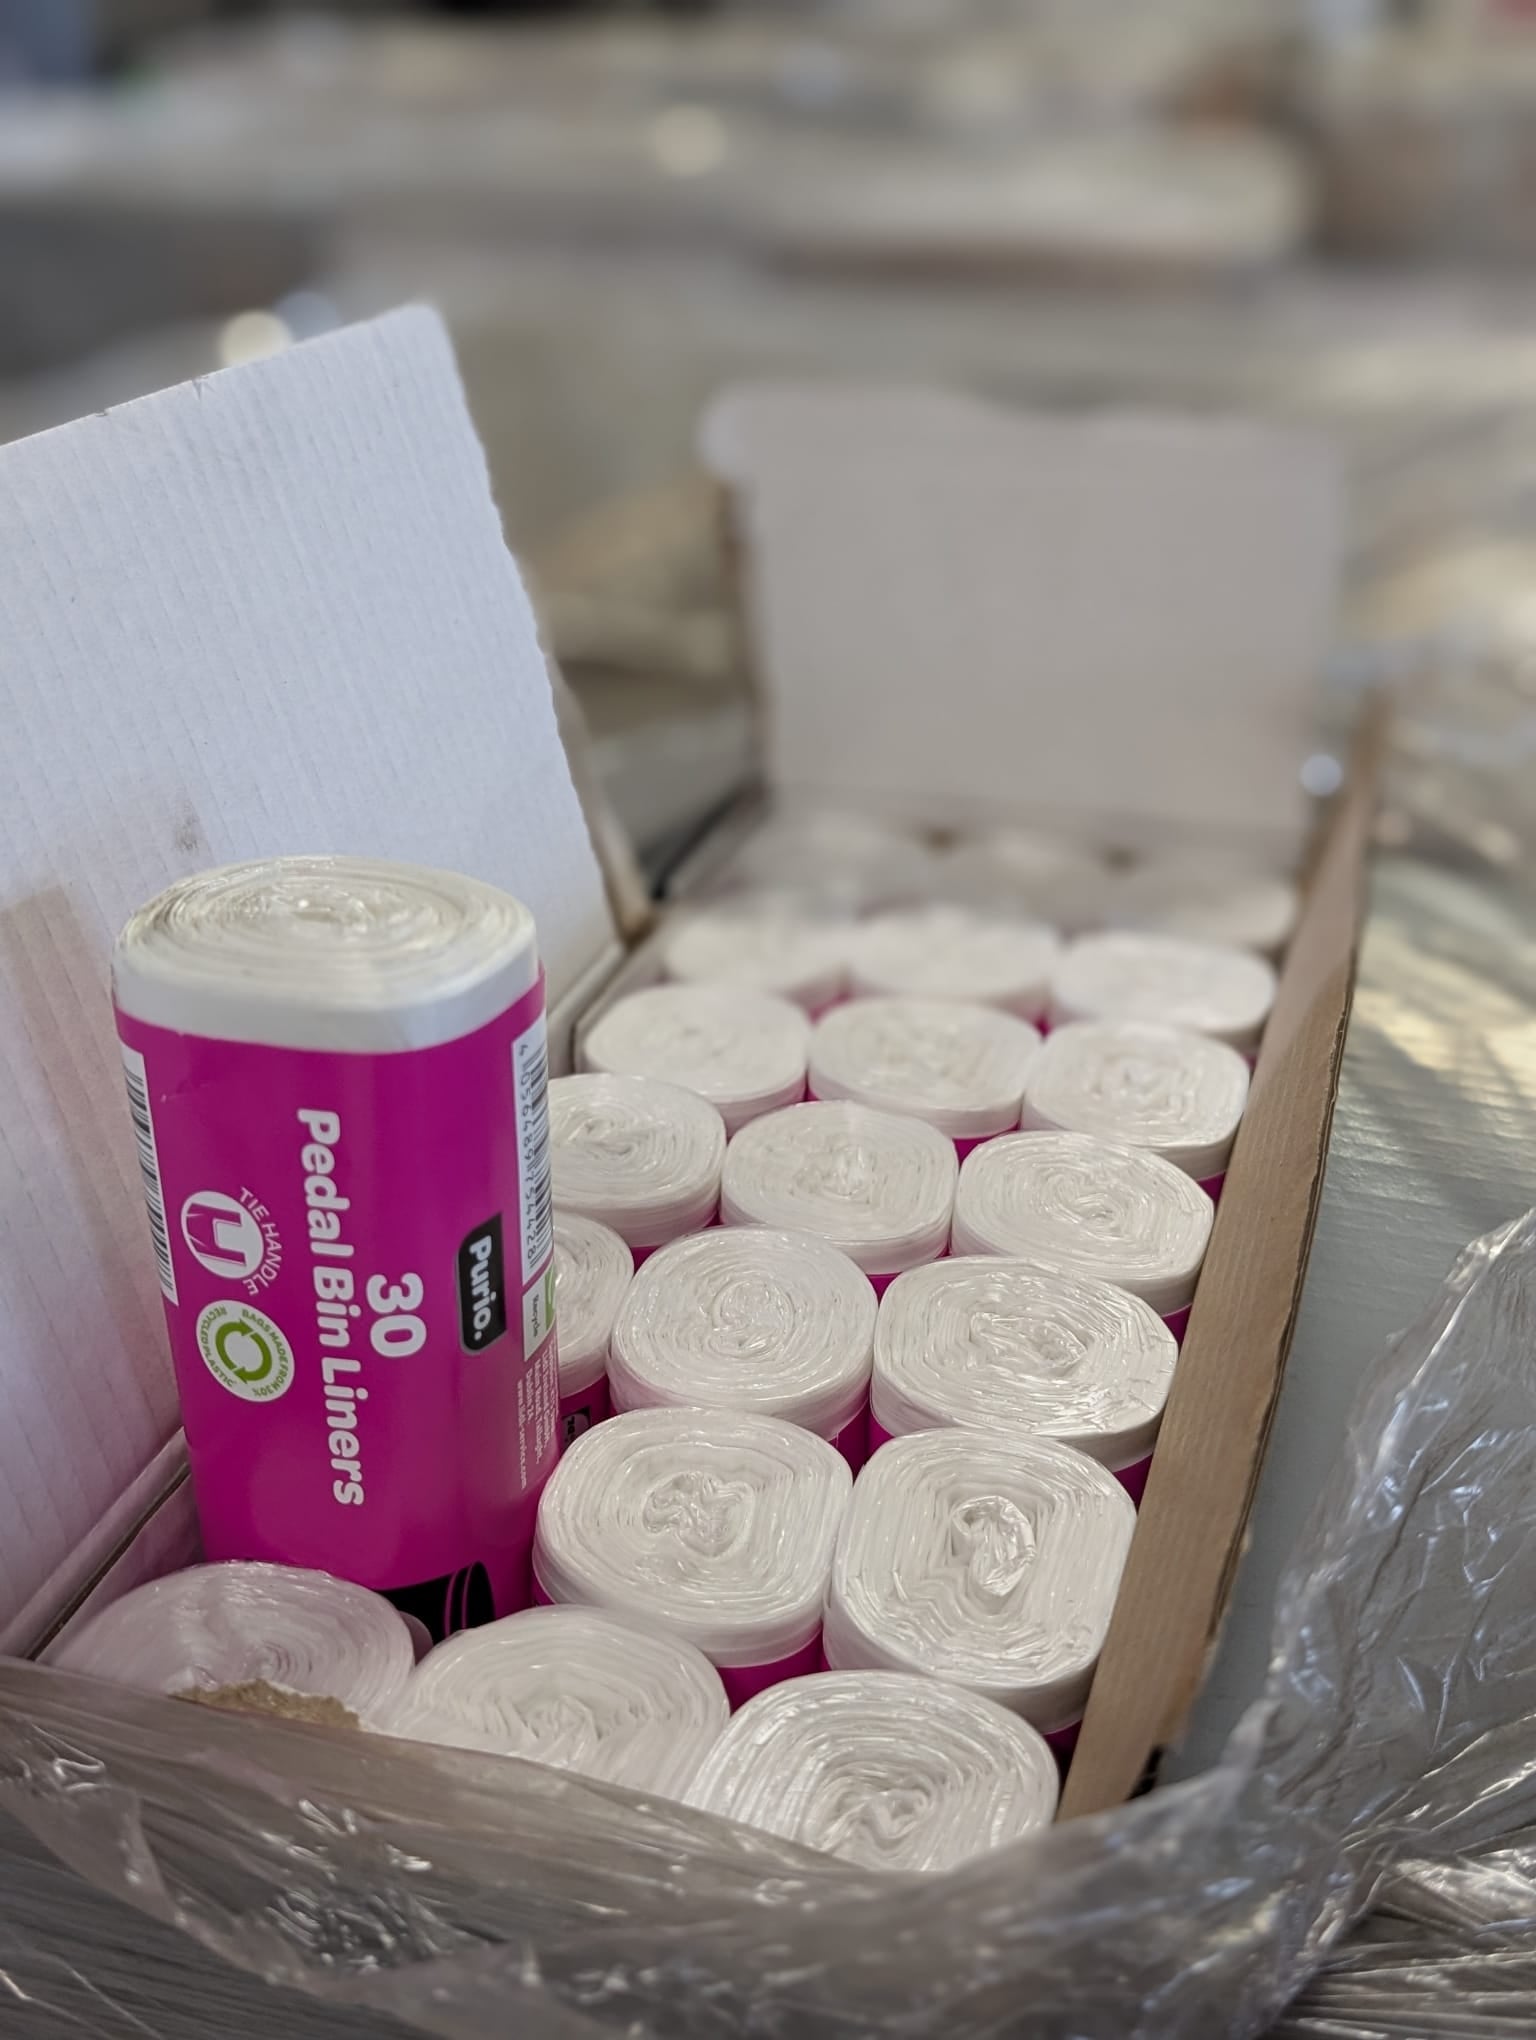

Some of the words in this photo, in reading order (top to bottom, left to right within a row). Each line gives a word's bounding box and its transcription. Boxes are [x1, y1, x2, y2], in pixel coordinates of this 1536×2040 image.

[239, 1187, 270, 1222] TIE
[297, 1108, 354, 1257] Pedal
[242, 1223, 282, 1295] HANDLE
[200, 1306, 227, 1345] RECYCLED
[242, 1308, 271, 1333] BAGS
[313, 1266, 362, 1347] Bin
[366, 1272, 427, 1358] 30
[270, 1327, 288, 1362] MADE
[271, 1362, 289, 1391] FROM
[321, 1357, 369, 1506] Liners
